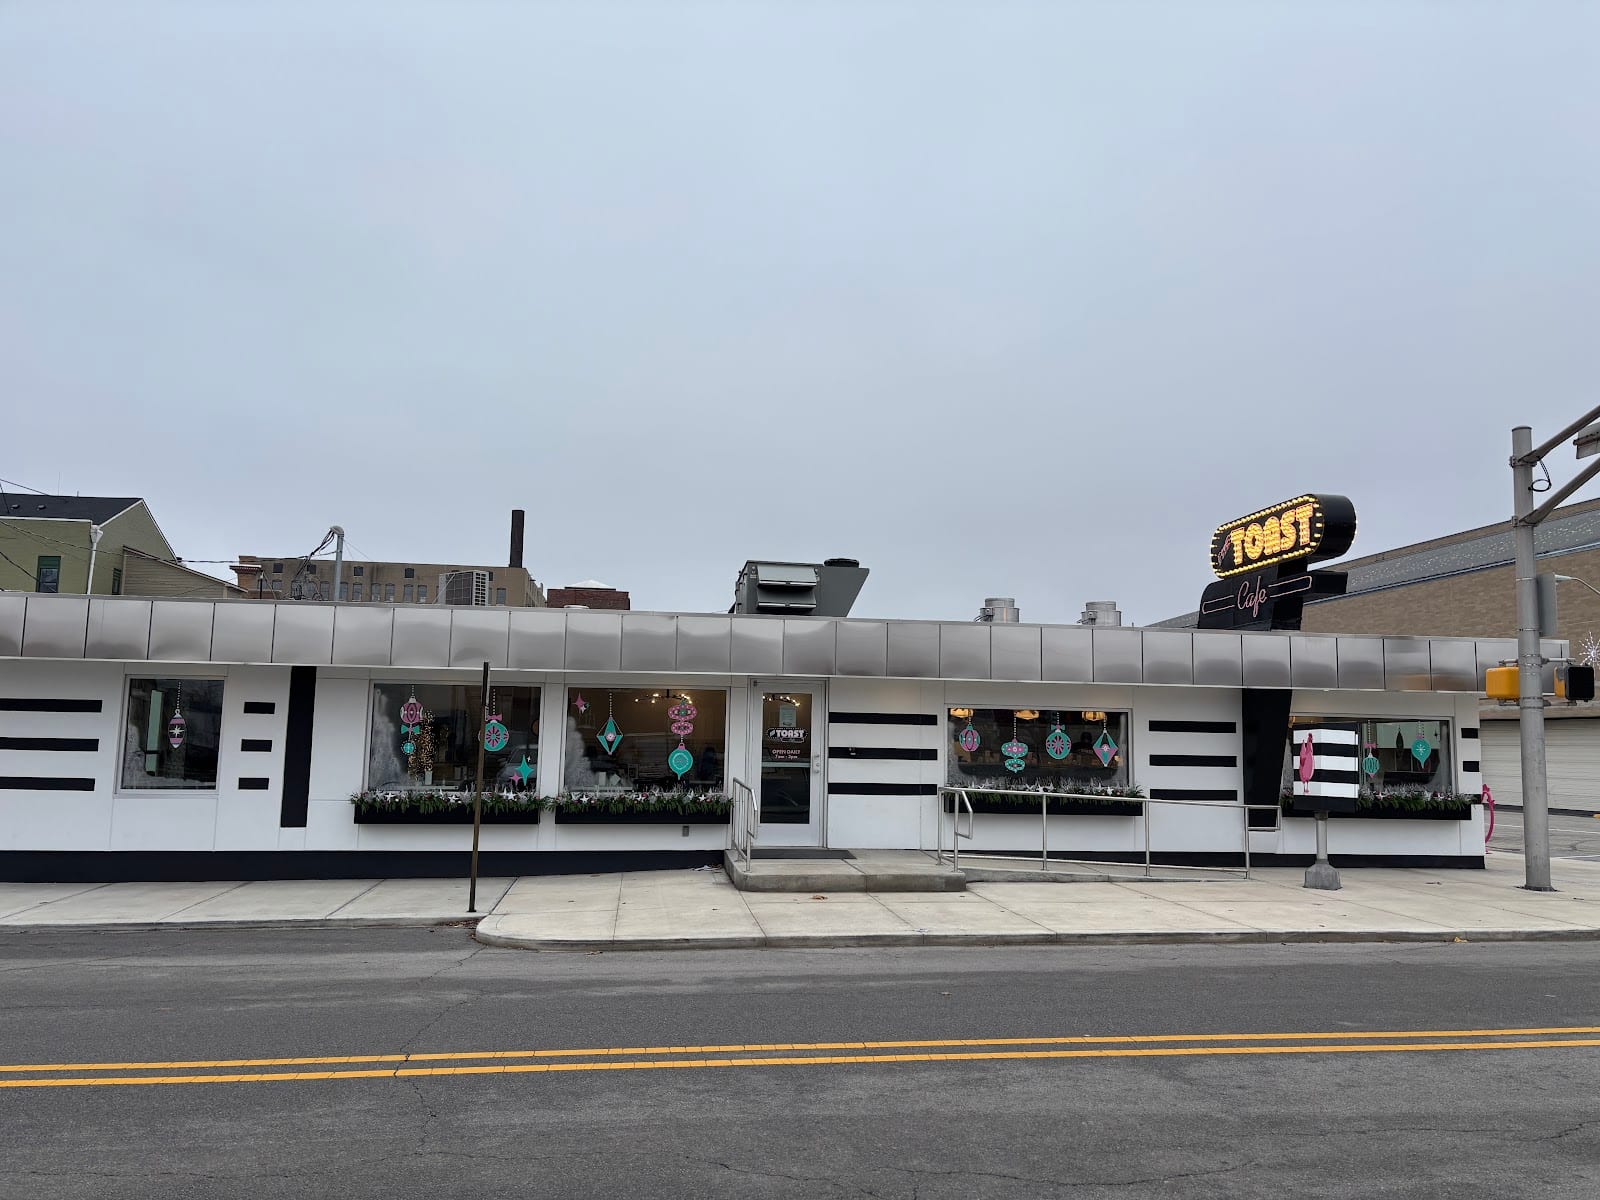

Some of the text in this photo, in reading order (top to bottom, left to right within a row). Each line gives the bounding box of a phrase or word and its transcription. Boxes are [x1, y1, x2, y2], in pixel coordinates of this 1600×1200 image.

[1230, 502, 1314, 566] TOAST
[1237, 575, 1267, 618] Cafe
[776, 729, 804, 738] TOAST
